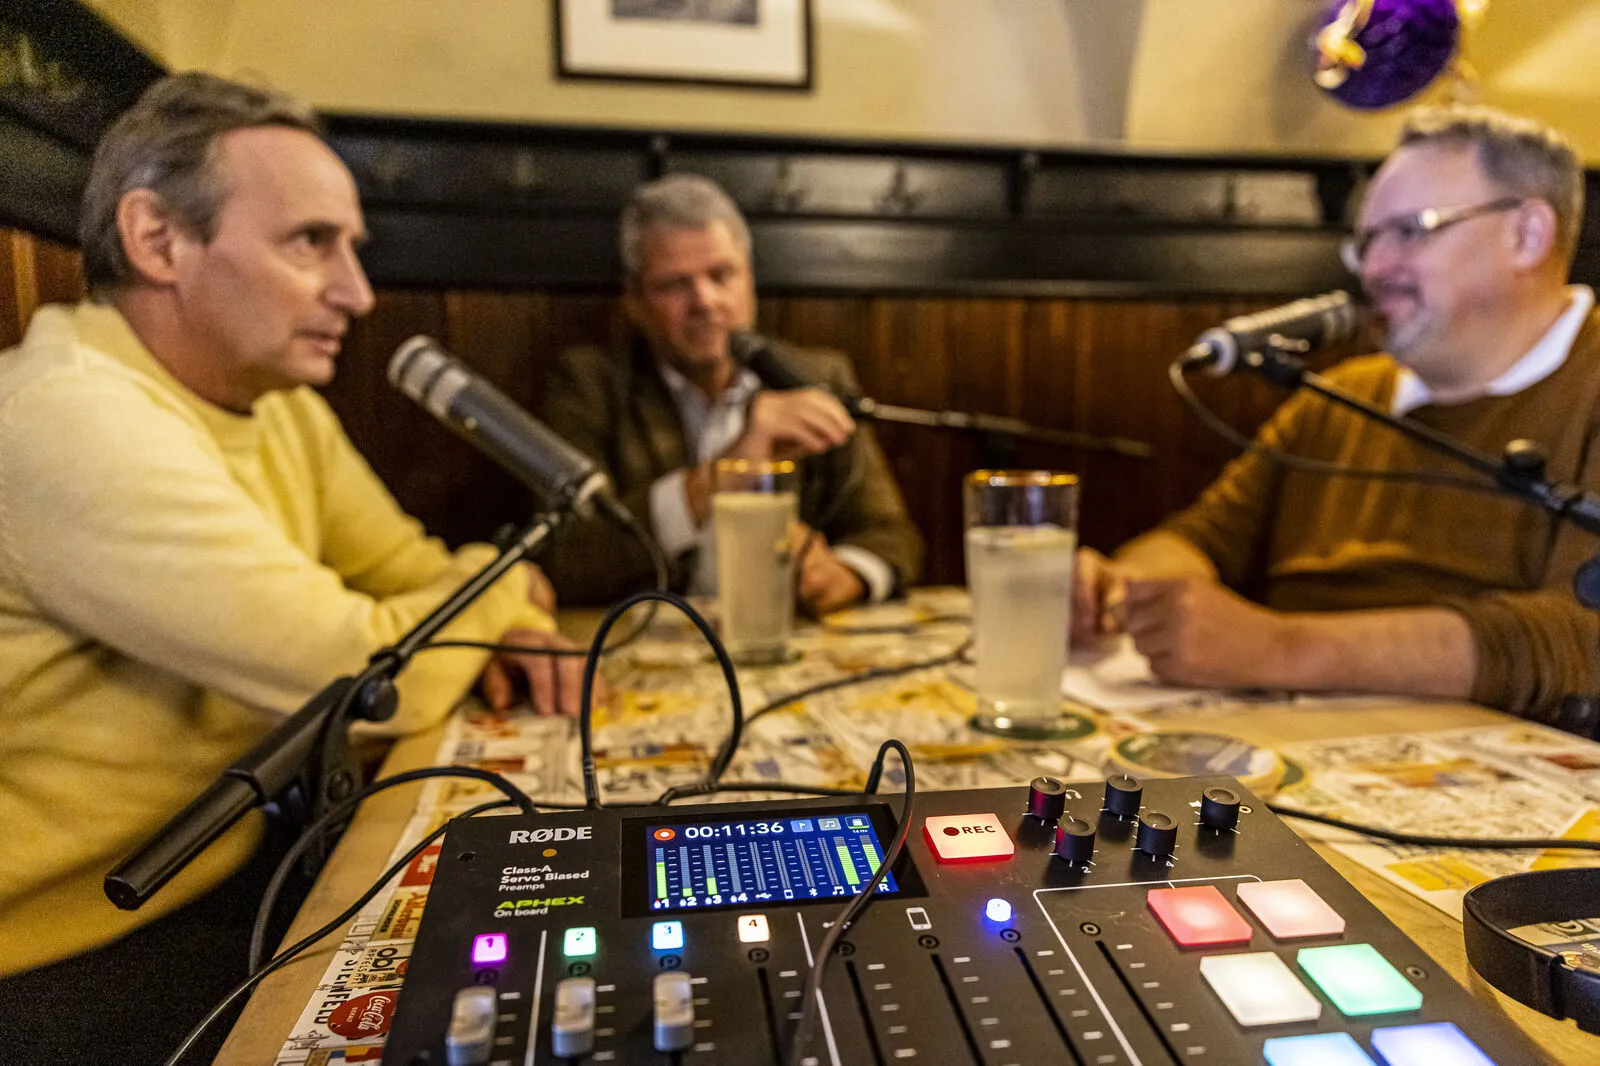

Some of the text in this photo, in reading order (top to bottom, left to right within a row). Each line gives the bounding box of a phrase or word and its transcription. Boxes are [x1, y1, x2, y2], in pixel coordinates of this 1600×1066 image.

[961, 825, 996, 834] REC
[1130, 820, 1139, 828] 3
[508, 826, 593, 844] RØDE
[684, 821, 785, 839] 00:11:36
[1165, 860, 1174, 868] 4
[502, 865, 553, 875] Class-A
[1081, 866, 1092, 874] 2
[500, 870, 590, 884] Servo Biased
[498, 882, 546, 892] Preamps
[661, 883, 890, 908] 1 2 3 4 L R
[496, 895, 585, 909] APHEX
[494, 906, 549, 918] On board
[748, 919, 758, 927] 4
[575, 930, 585, 941] 2
[663, 924, 672, 936] 3
[485, 937, 495, 948] 1
[369, 947, 412, 973] obi
